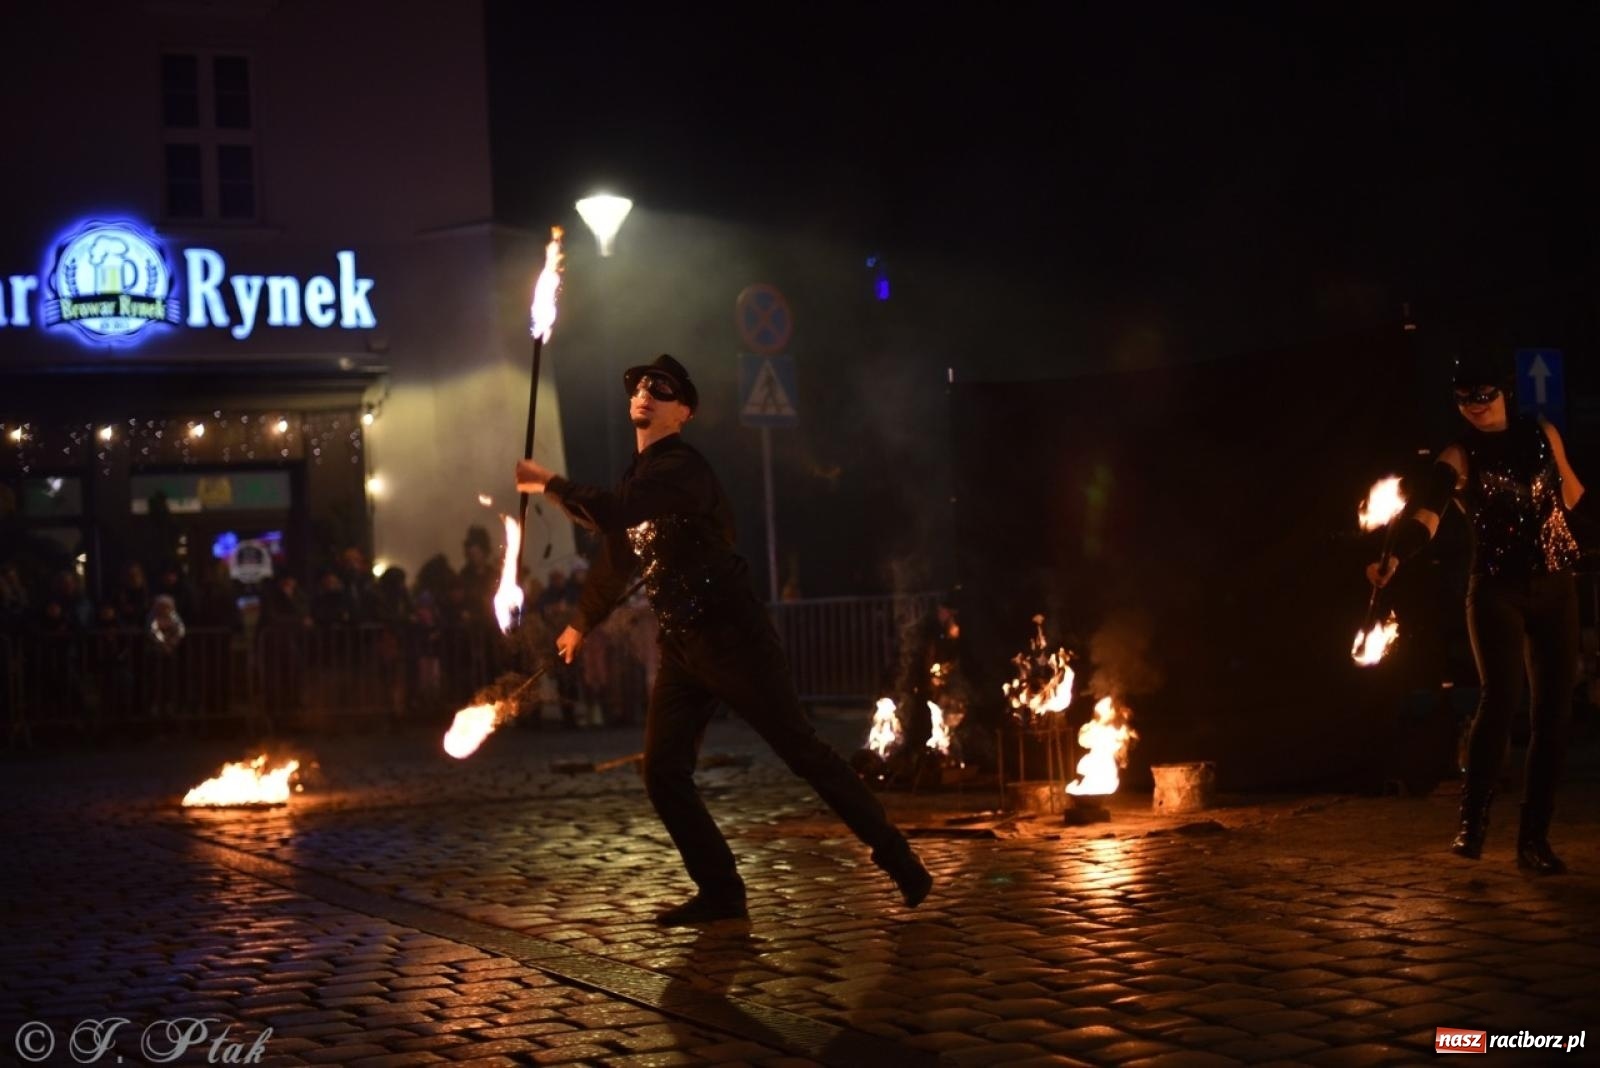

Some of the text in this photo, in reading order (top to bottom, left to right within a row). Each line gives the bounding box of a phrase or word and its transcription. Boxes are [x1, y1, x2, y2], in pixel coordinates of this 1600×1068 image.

[0, 248, 376, 339] r Rynek
[60, 295, 166, 320] Browar Rynek
